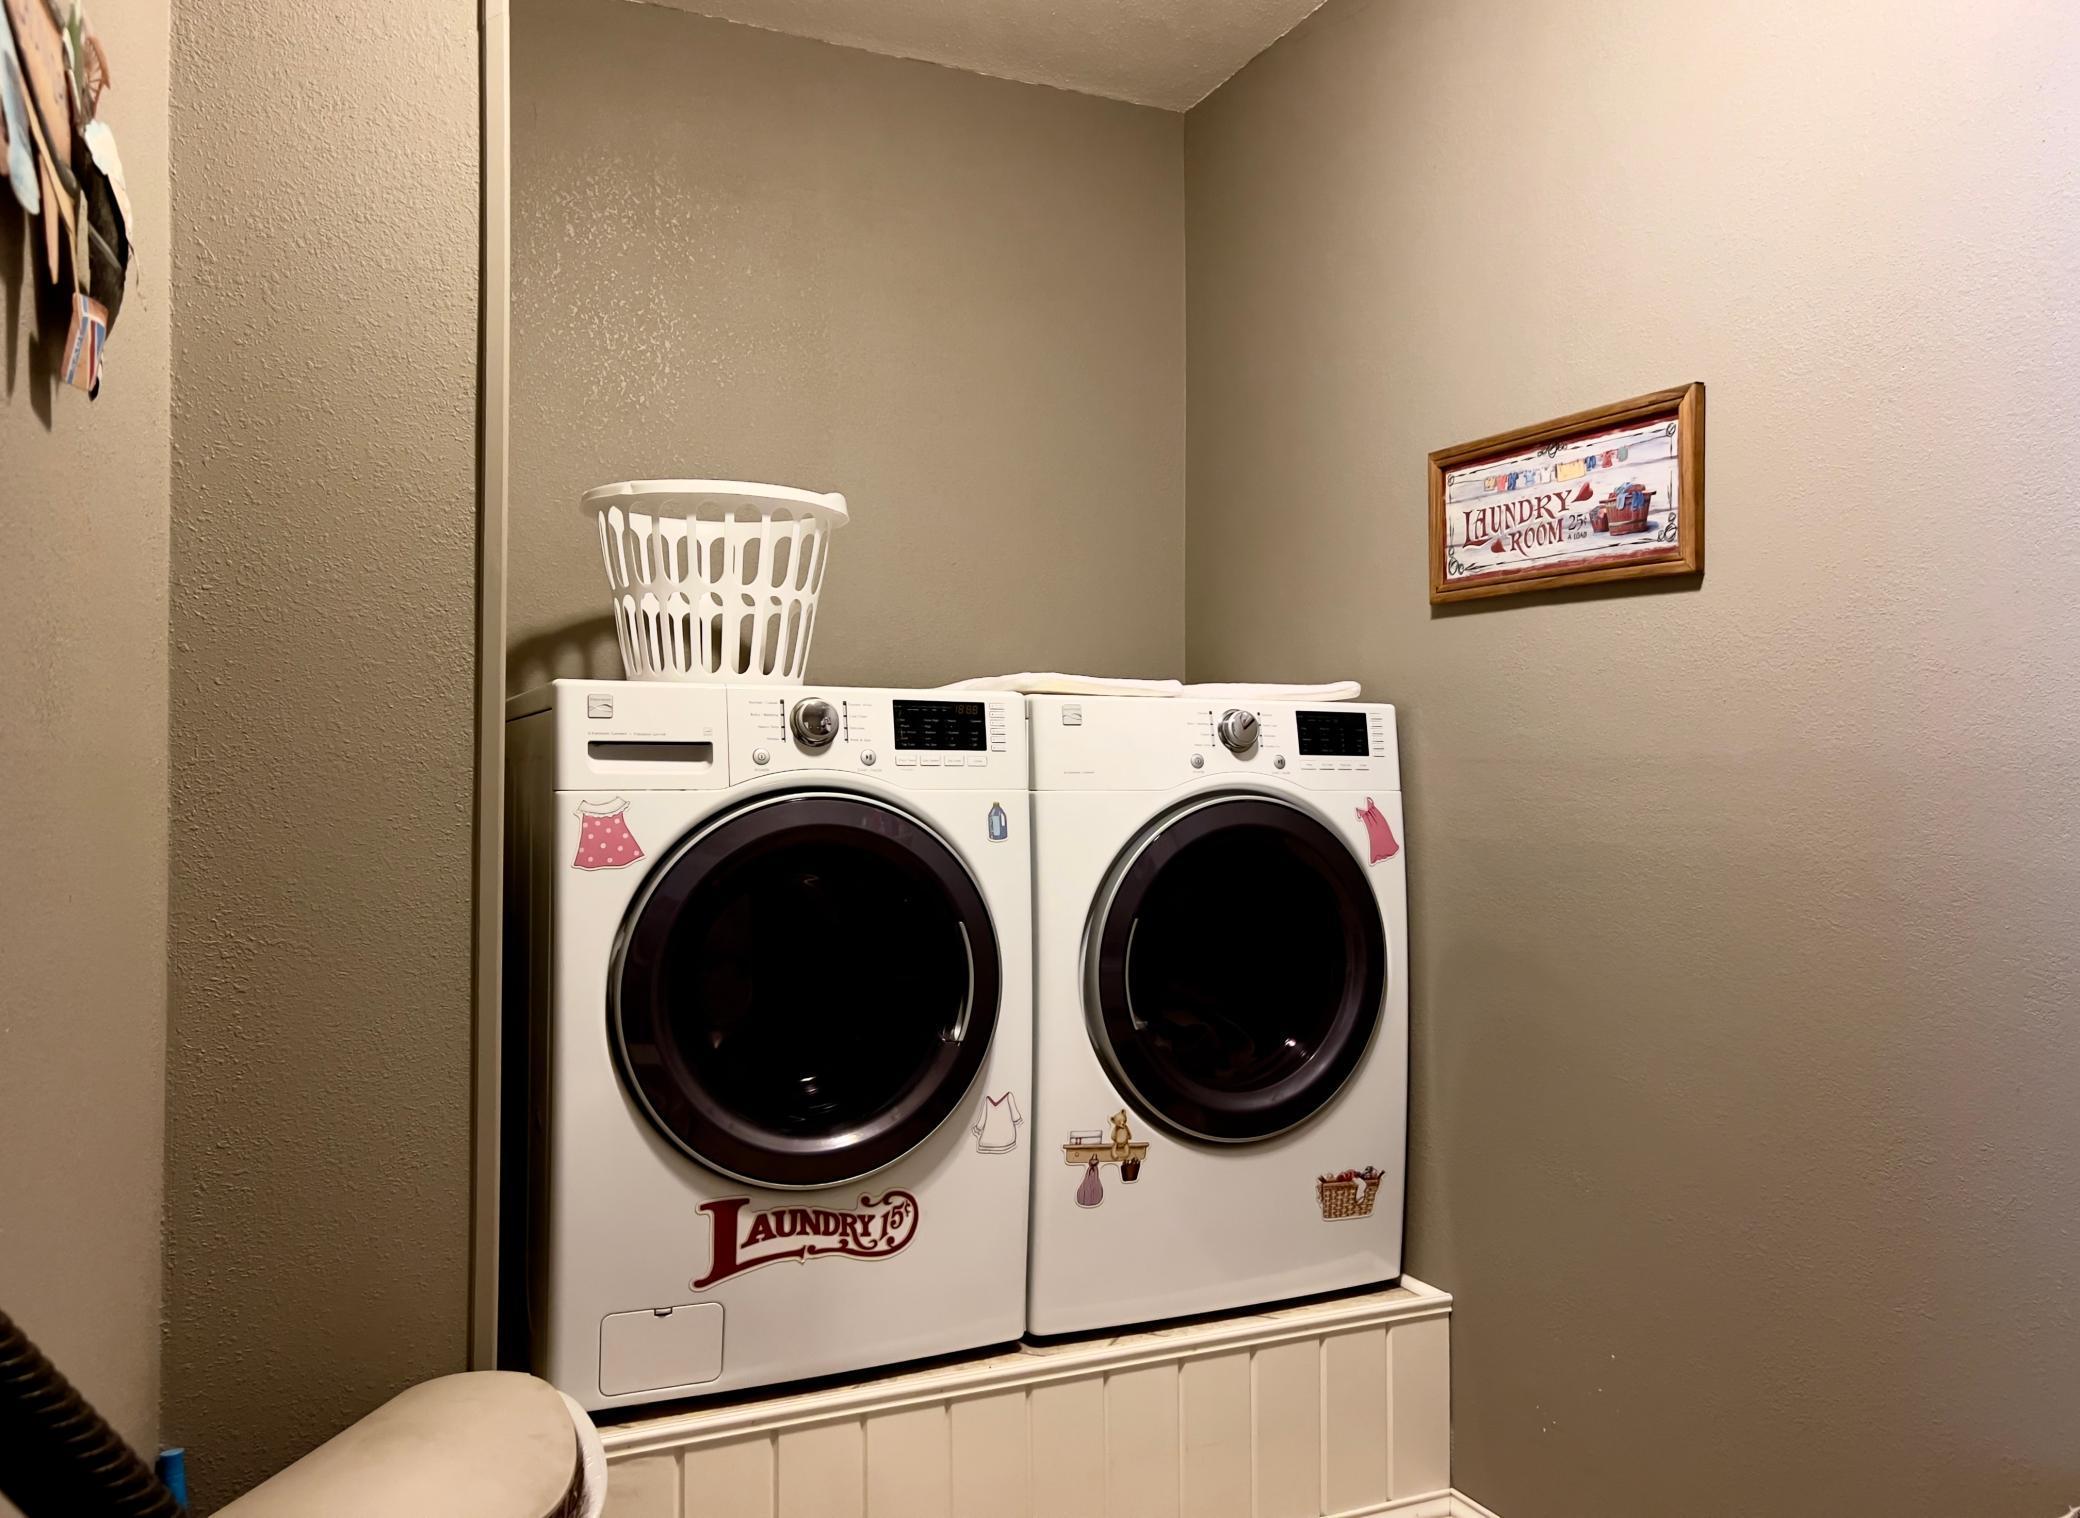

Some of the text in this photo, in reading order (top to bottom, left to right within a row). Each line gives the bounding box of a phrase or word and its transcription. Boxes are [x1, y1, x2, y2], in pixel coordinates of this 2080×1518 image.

[1462, 489, 1572, 549] LAUNDRY
[1510, 518, 1564, 557] ROOM
[694, 1198, 911, 1288] LAUNDRY 15¢
